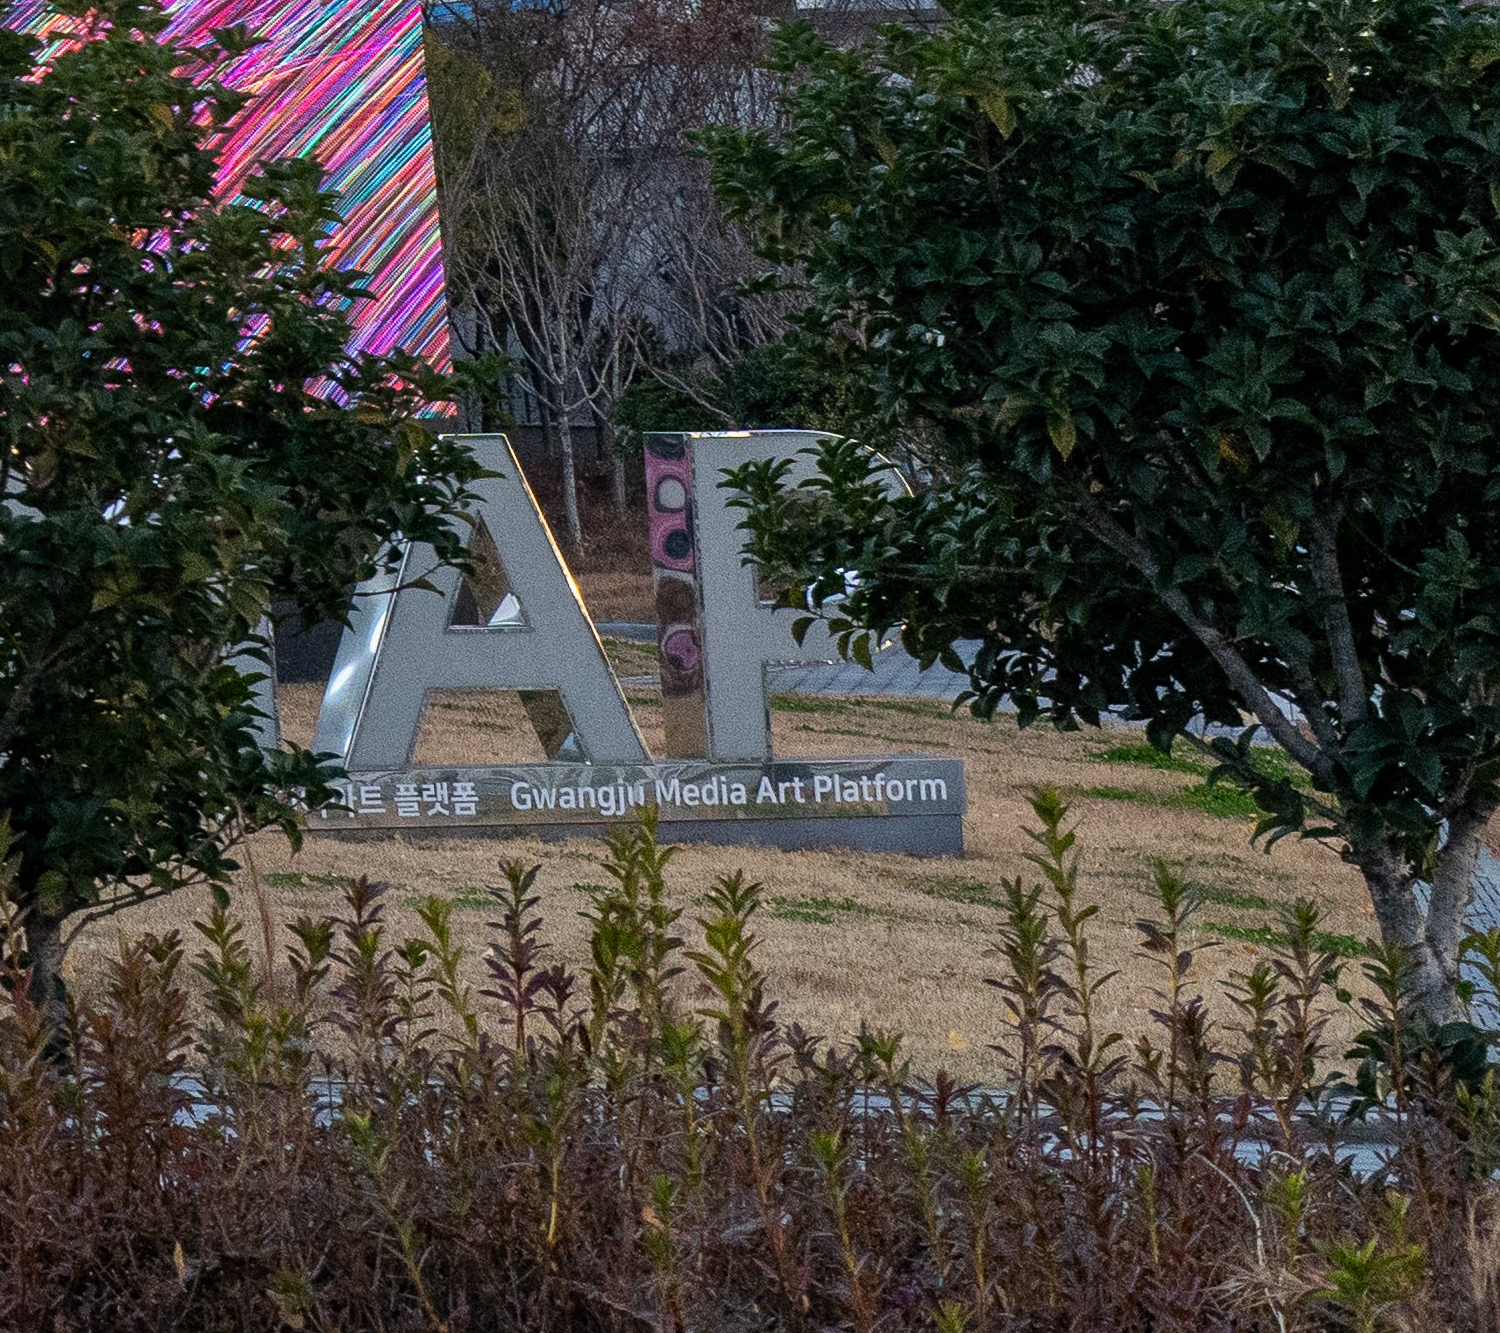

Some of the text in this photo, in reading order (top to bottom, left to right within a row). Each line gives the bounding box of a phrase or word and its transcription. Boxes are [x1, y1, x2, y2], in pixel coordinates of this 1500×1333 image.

[393, 781, 479, 817] 플랫폼
[511, 772, 948, 817] Gwangju Media Art Platform
